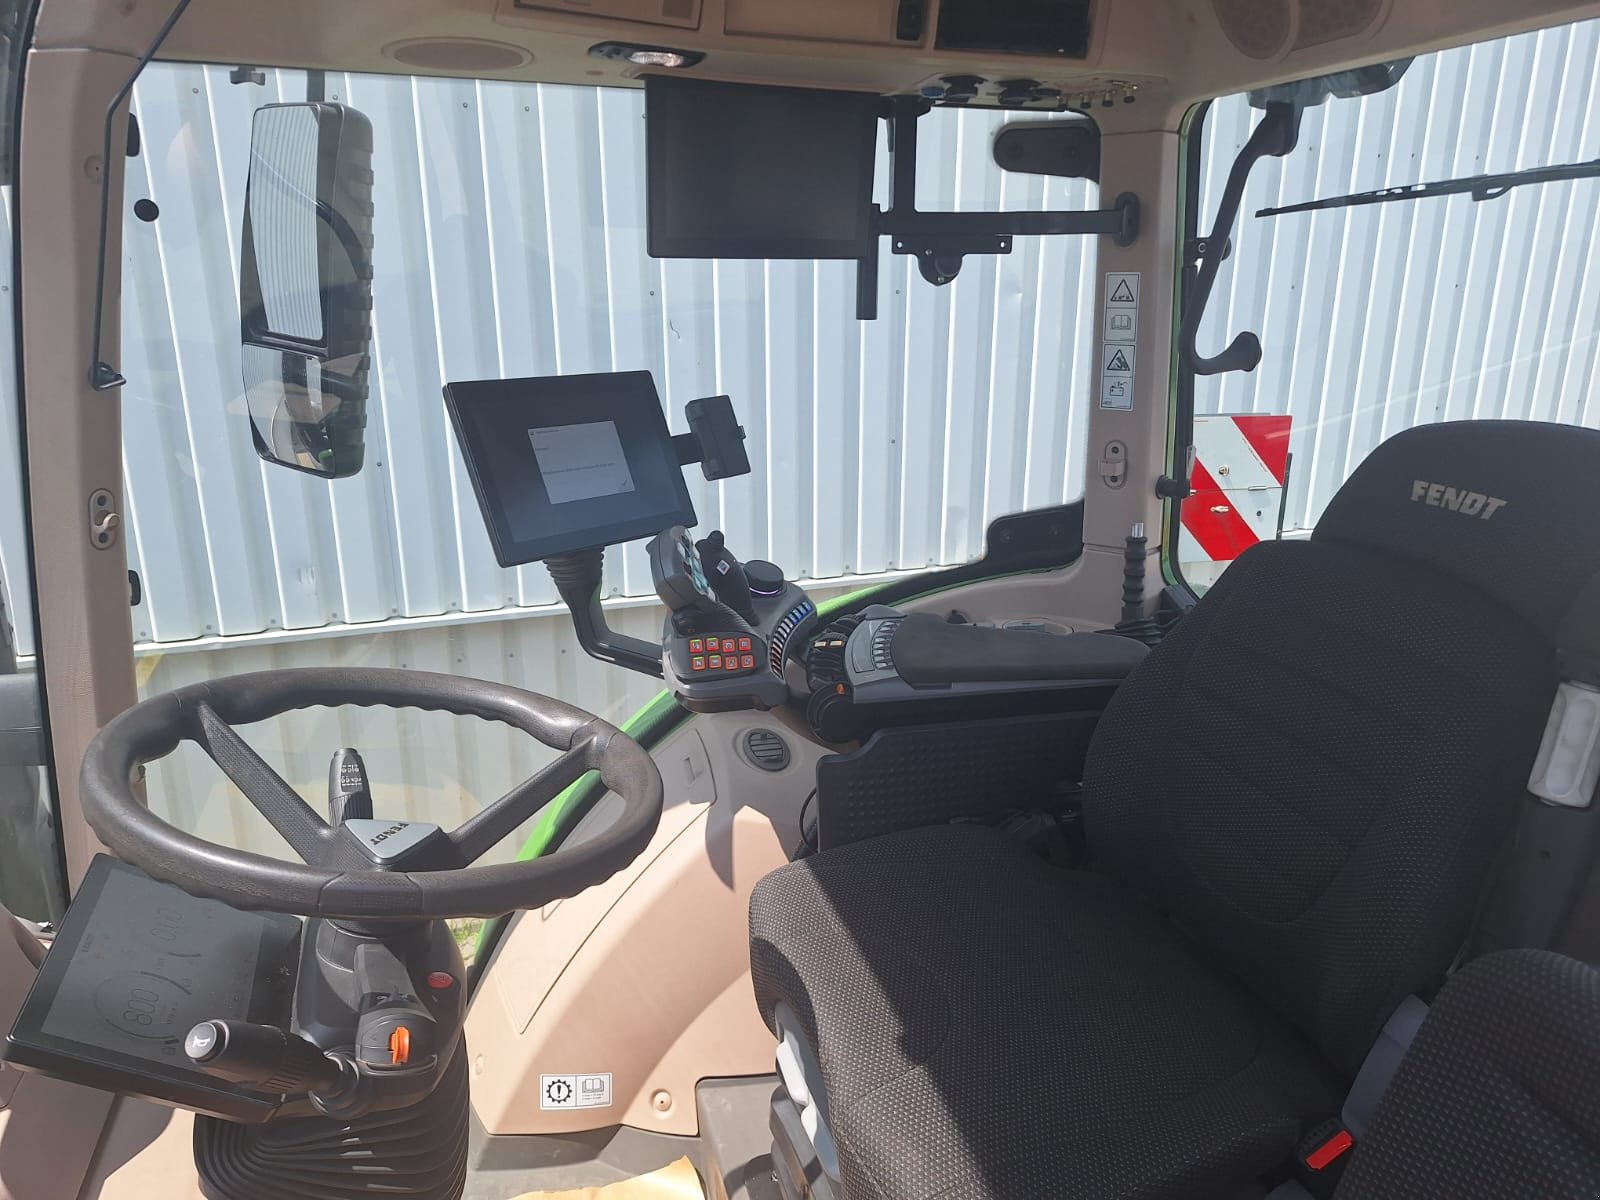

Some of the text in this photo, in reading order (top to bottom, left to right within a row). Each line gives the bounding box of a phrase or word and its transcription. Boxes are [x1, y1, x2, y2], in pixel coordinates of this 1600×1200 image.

[1410, 479, 1507, 520] FENDT
[370, 822, 410, 846] FENDT
[122, 988, 159, 1026] 800
